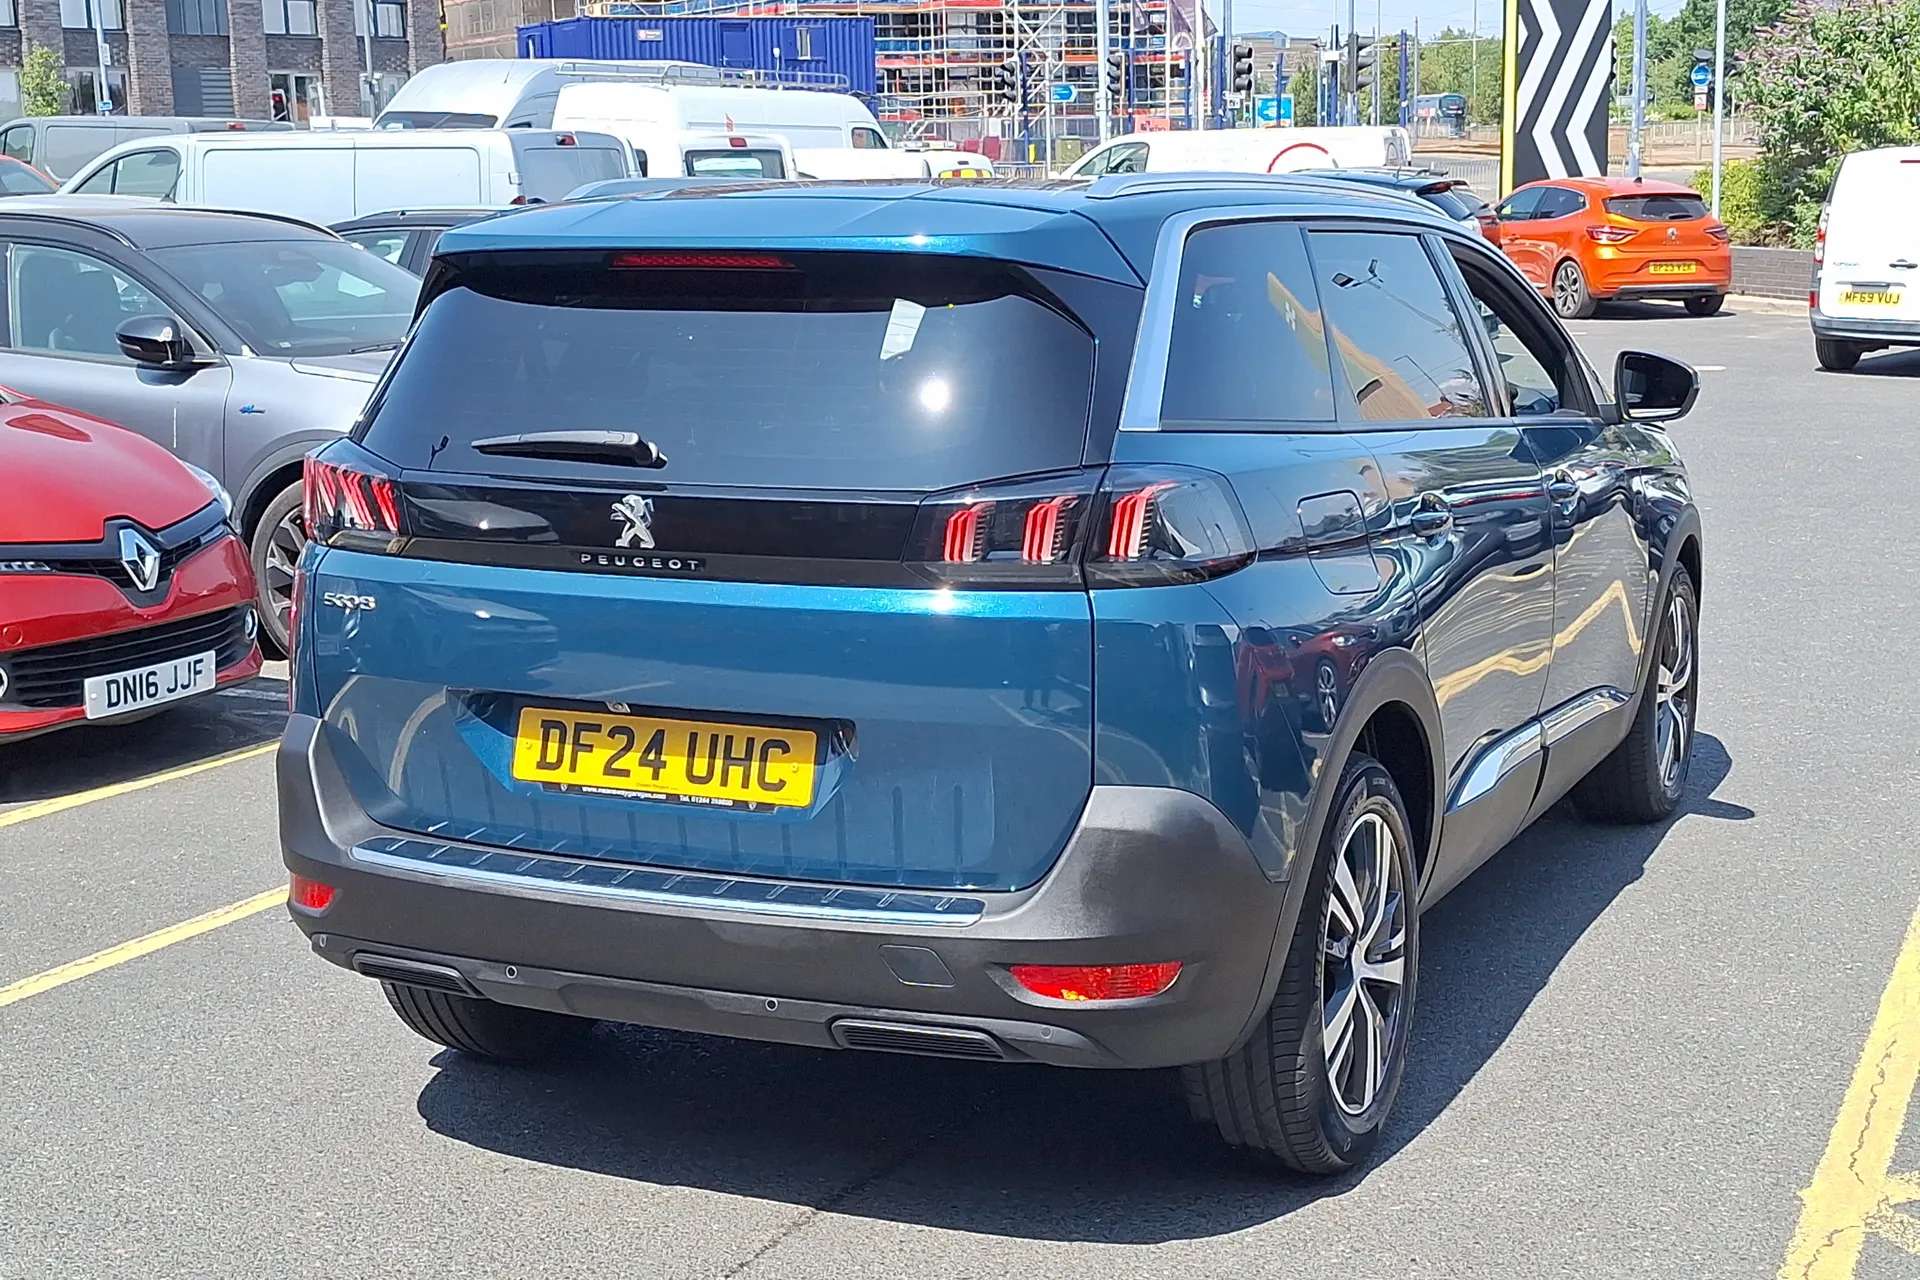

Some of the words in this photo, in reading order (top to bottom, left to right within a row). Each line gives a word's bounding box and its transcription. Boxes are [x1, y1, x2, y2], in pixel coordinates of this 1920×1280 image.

[1844, 291, 1874, 303] MF69
[1878, 293, 1900, 304] VUJ
[580, 553, 700, 571] PEUGEOT
[323, 592, 376, 610] 5008
[105, 670, 159, 709] DN16
[166, 658, 205, 693] JJF
[536, 719, 667, 781] DF24
[685, 731, 792, 792] UHC
